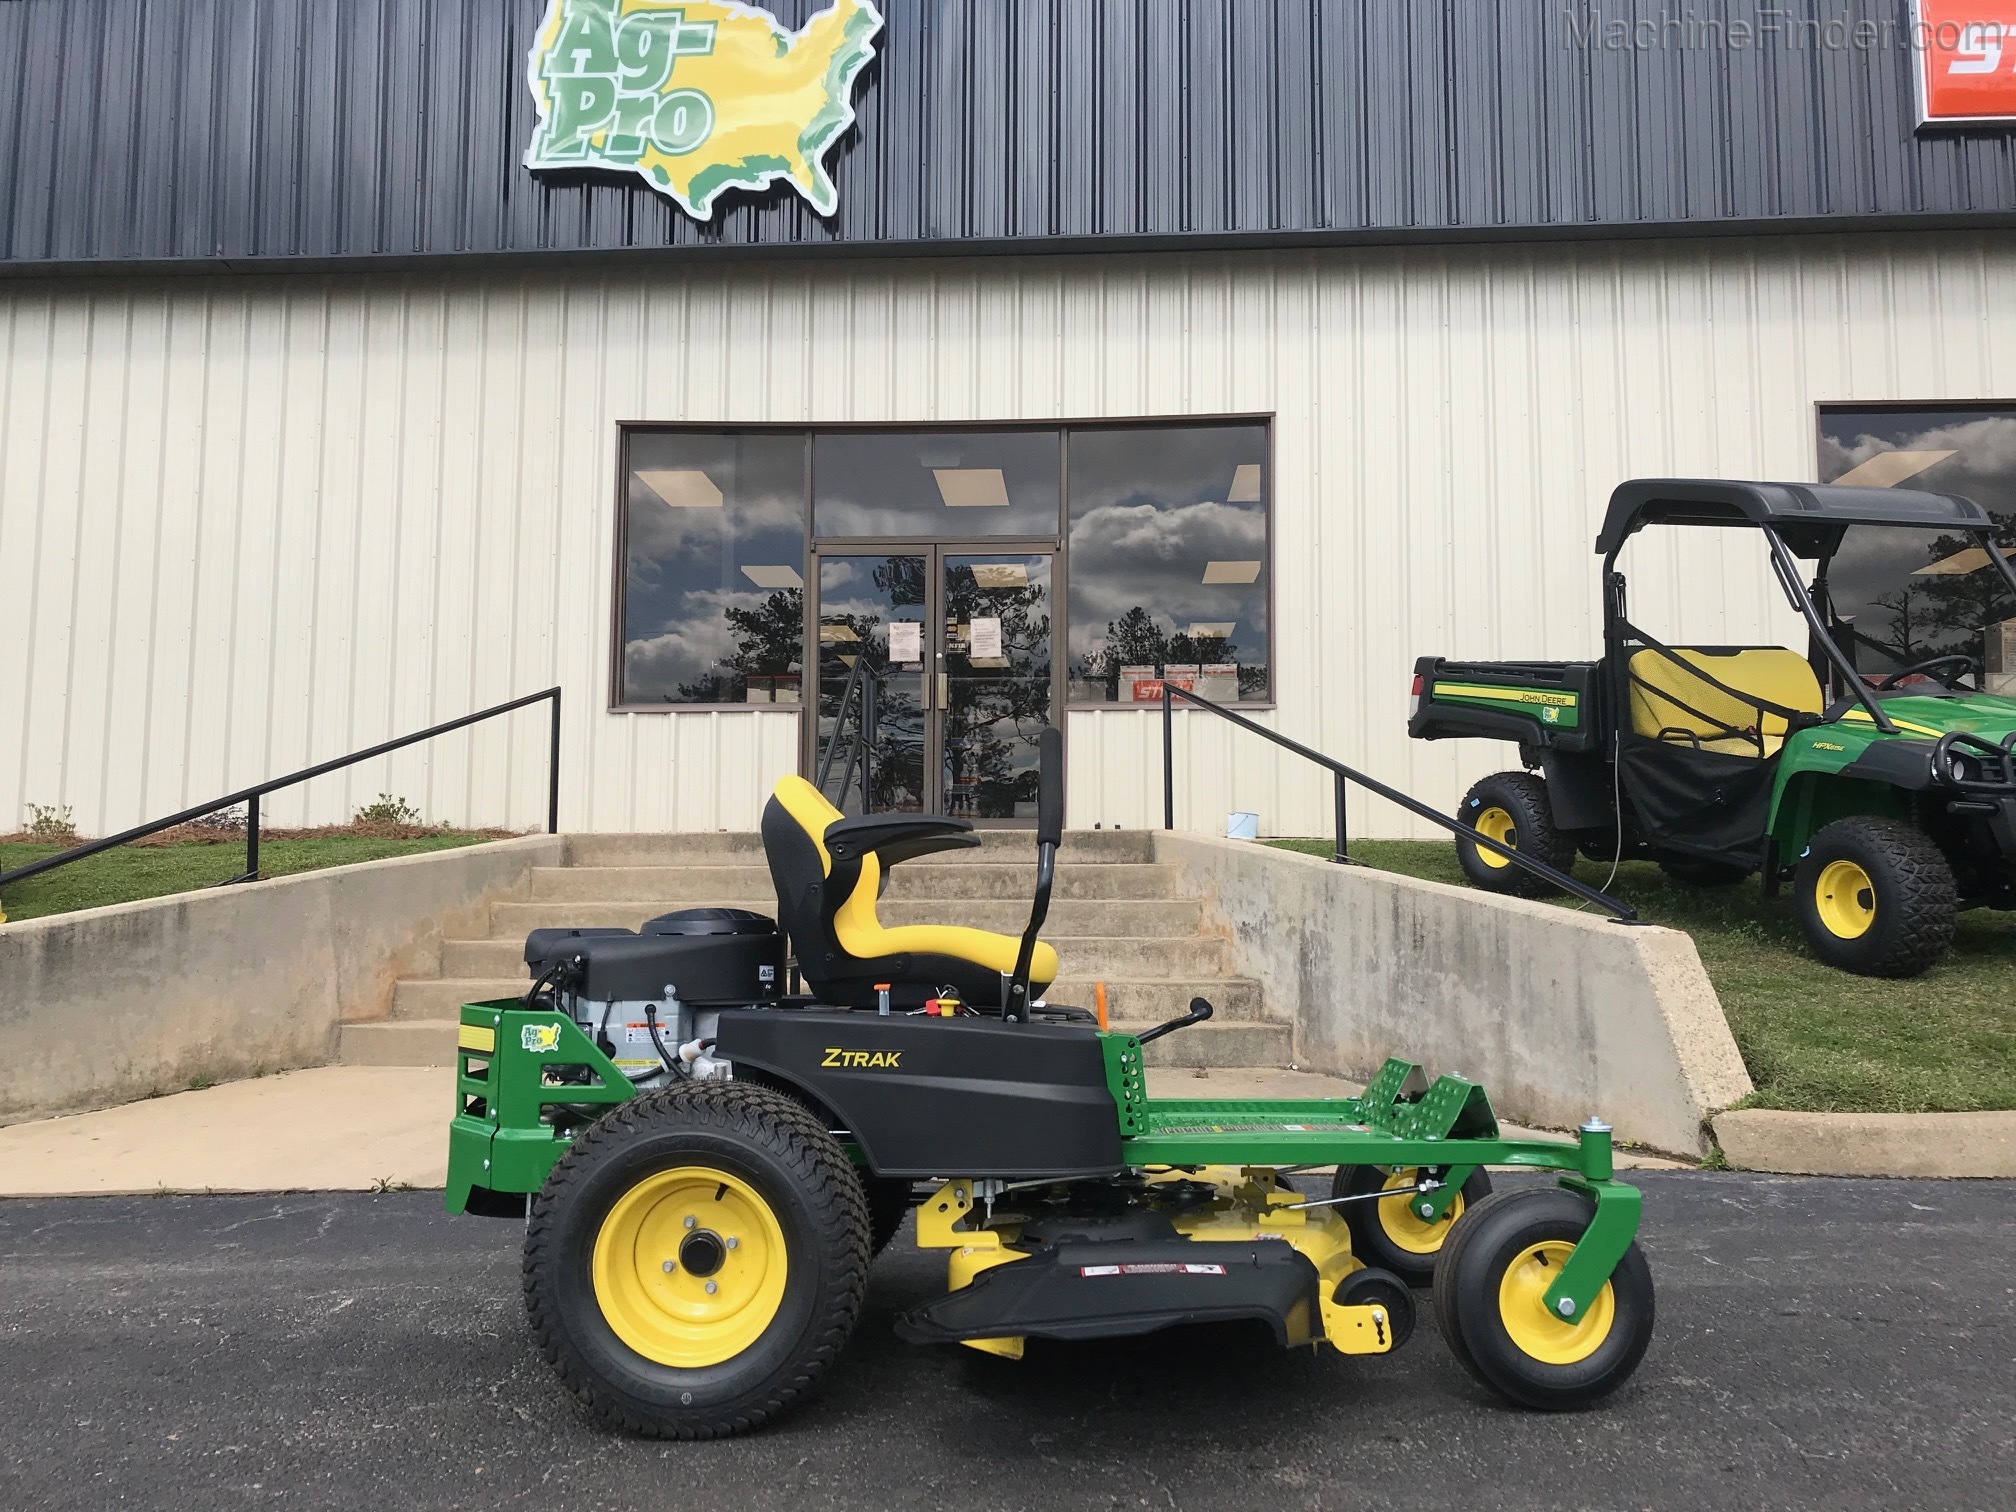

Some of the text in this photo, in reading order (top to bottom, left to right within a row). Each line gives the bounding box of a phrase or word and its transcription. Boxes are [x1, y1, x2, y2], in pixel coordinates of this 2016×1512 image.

[542, 0, 717, 93] Ag-
[538, 75, 715, 156] Pro
[1519, 693, 1567, 705] JOHN DEERE
[524, 1027, 542, 1038] Ag-
[525, 1036, 543, 1046] Pro
[820, 1048, 903, 1067] ZTRAK
